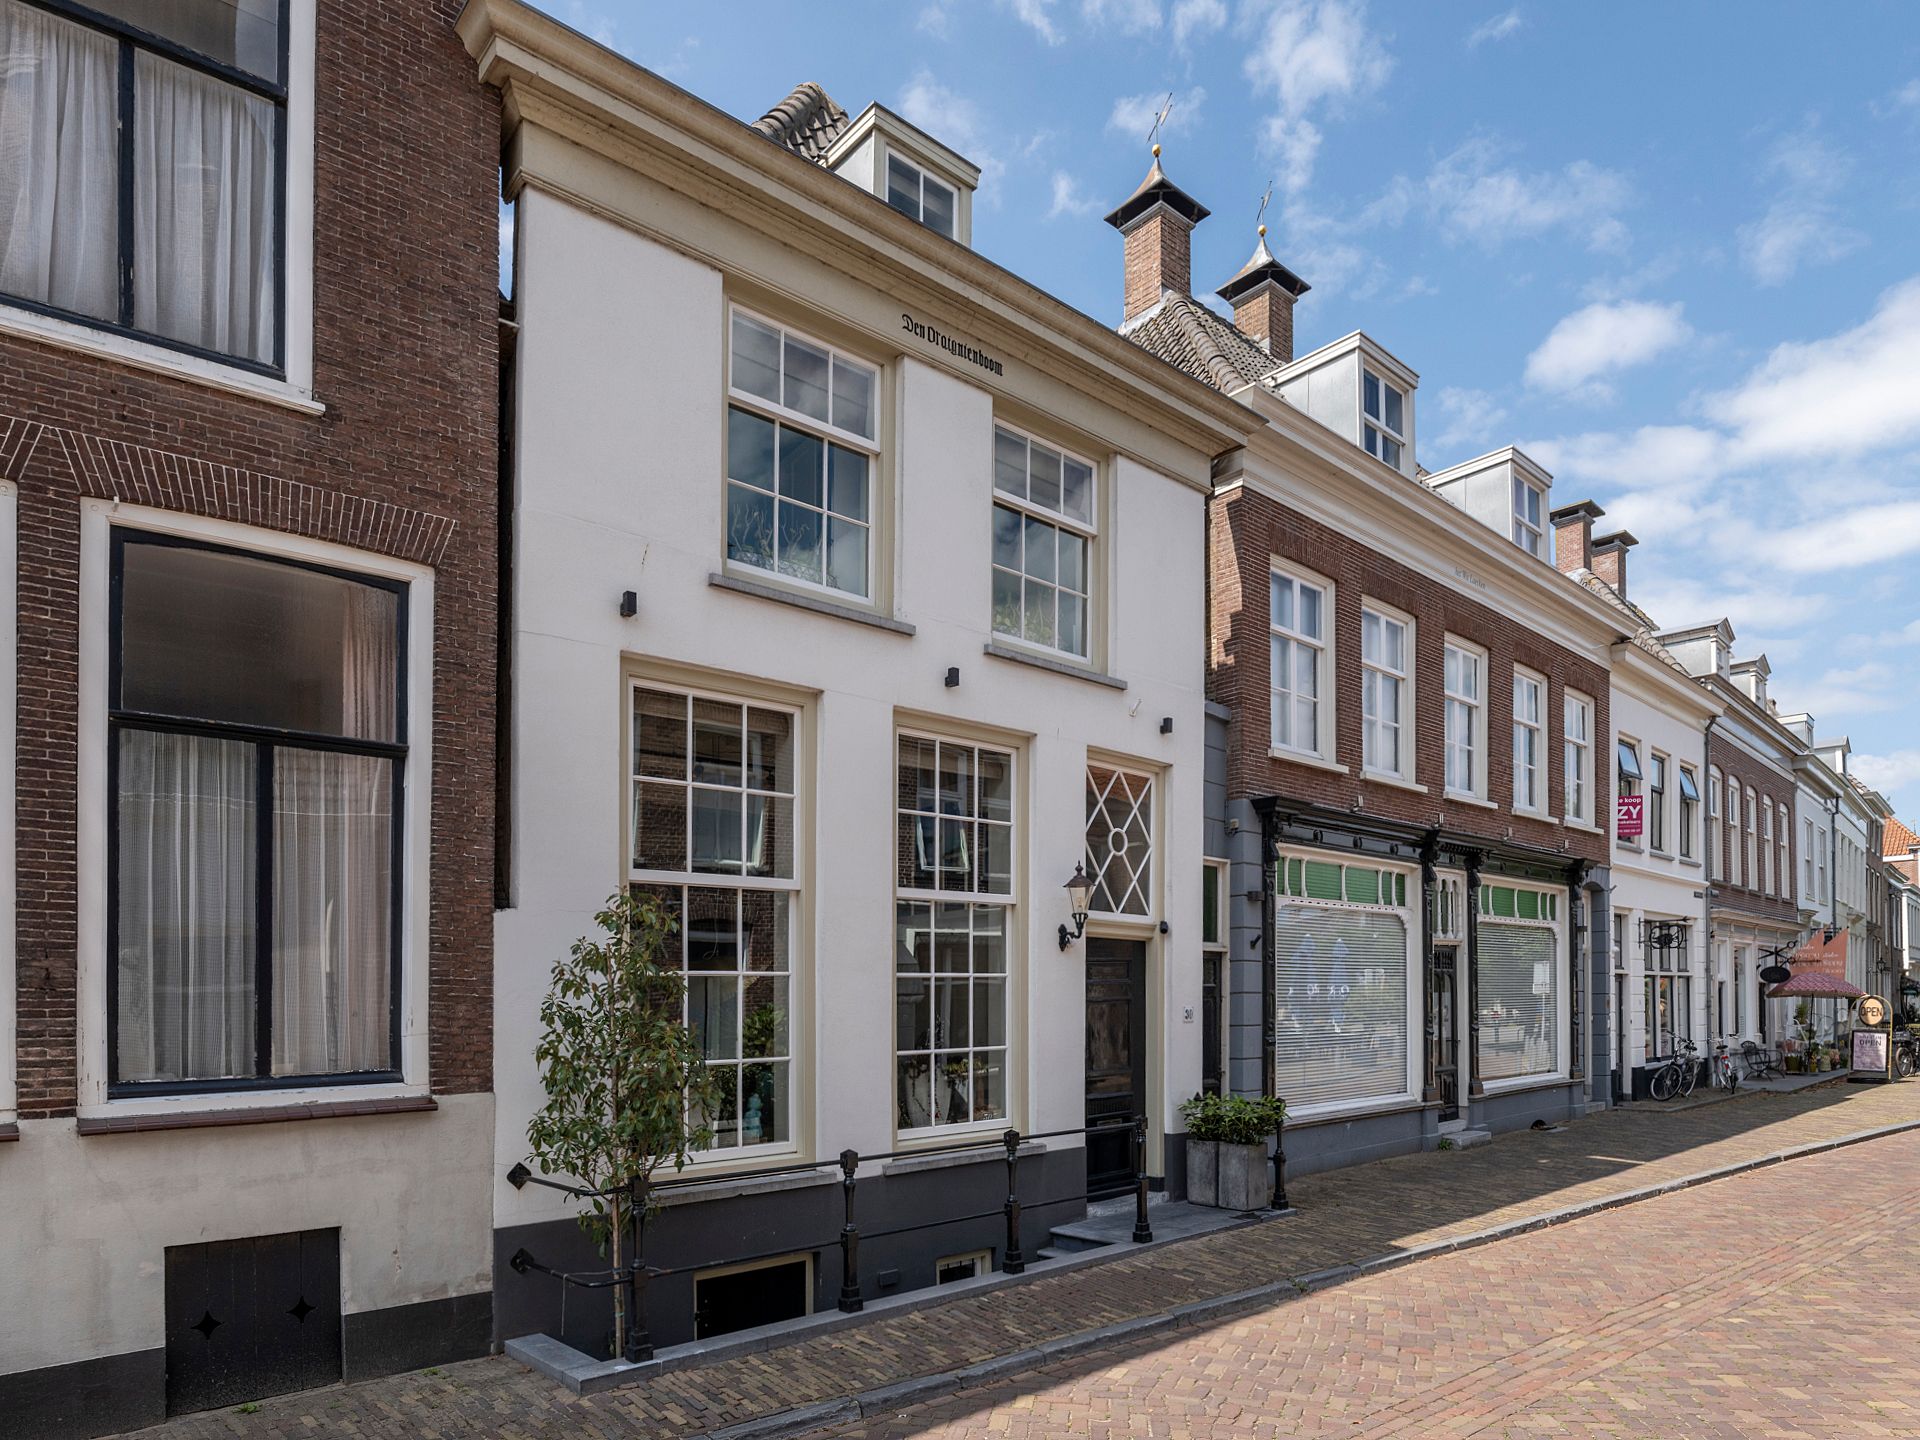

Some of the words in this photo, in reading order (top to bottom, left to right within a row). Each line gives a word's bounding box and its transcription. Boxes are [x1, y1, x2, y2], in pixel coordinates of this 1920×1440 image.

[902, 313, 925, 339] Den
[1860, 1006, 1883, 1017] OPEN
[1859, 1039, 1882, 1047] OPEN
